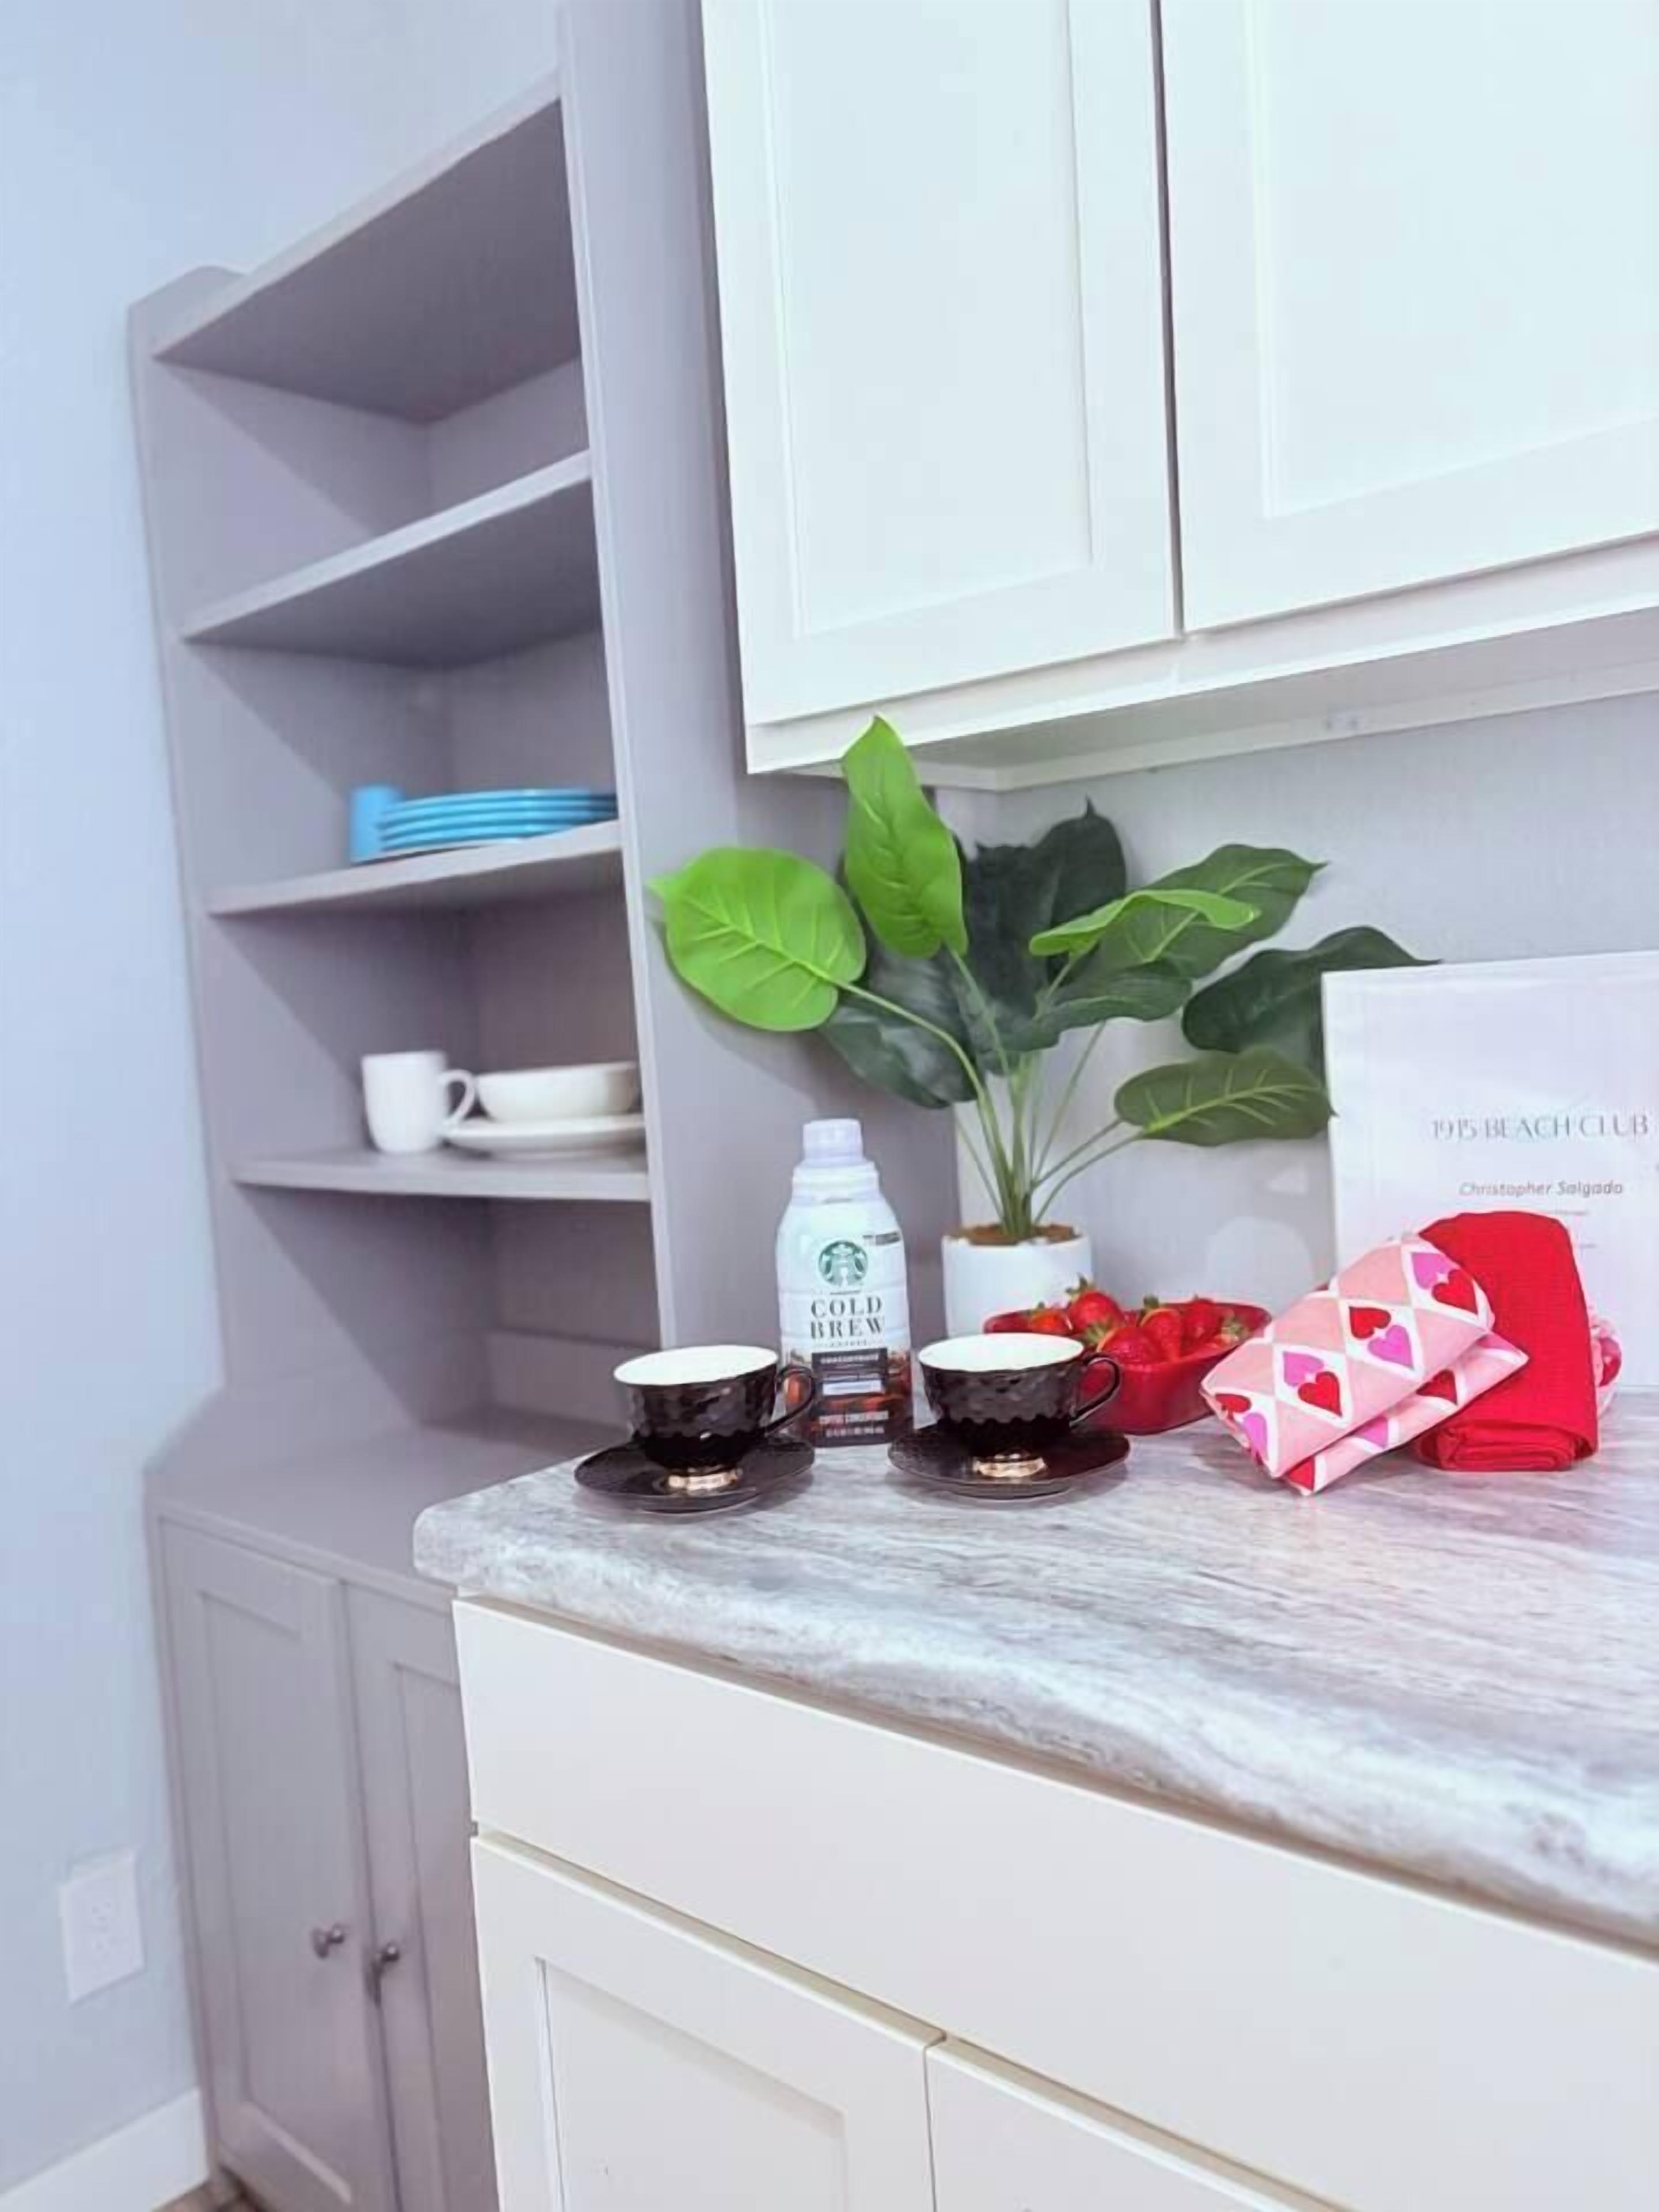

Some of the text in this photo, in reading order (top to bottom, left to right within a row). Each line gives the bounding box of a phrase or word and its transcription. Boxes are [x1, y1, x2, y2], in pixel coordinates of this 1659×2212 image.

[1485, 1115, 1571, 1140] BEACH
[1580, 1113, 1649, 1138] CLUB
[1459, 1180, 1623, 1198] Christopher Salgado
[811, 1297, 882, 1318] COLD
[811, 1316, 885, 1339] BREW
